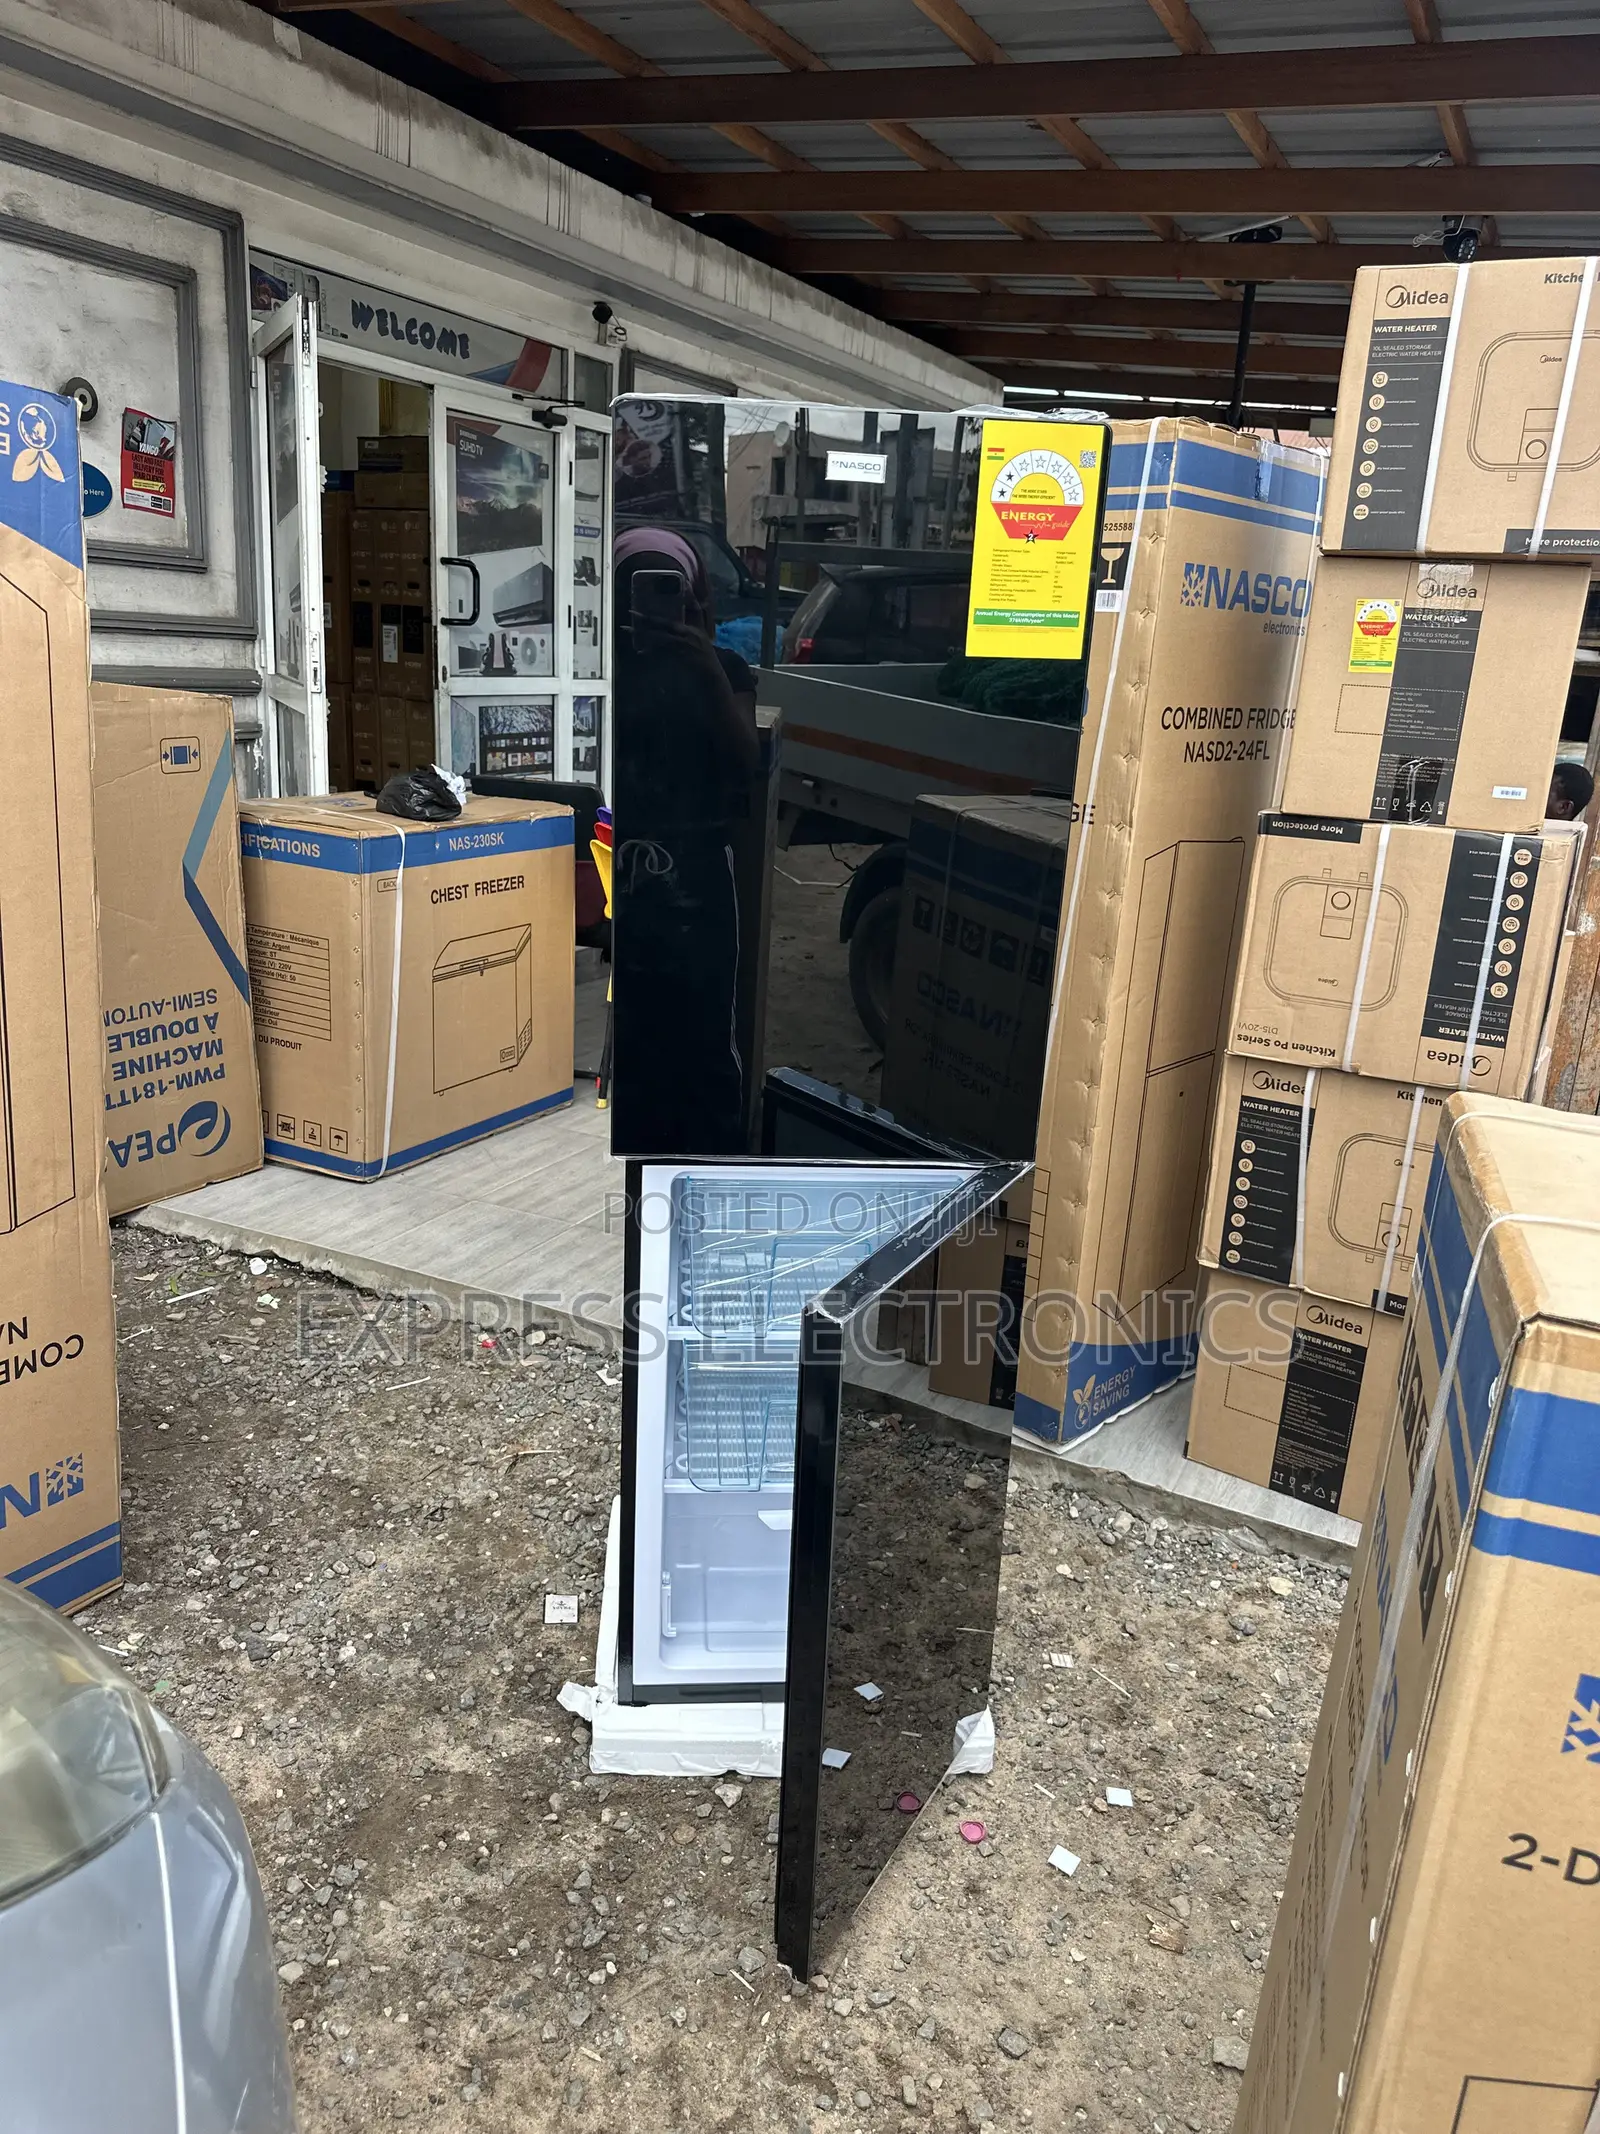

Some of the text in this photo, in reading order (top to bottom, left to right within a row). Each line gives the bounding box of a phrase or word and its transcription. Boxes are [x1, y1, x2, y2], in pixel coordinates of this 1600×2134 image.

[1544, 272, 1584, 285] Kitche
[1385, 285, 1449, 308] Midea
[351, 298, 470, 360] WELCOME
[1404, 324, 1438, 333] HEATER
[138, 442, 159, 456] YANGO
[839, 460, 882, 471] NASCO
[89, 489, 105, 497] Here
[1001, 510, 1056, 522] ENERGY
[1103, 522, 1135, 532] 525588
[1028, 533, 1034, 541] 2
[1525, 537, 1600, 547] Mre protectio
[1203, 565, 1313, 618] NASCO
[1416, 577, 1478, 598] Midea
[1404, 613, 1433, 621] WATER
[1161, 706, 1243, 731] COMBINED
[1184, 740, 1270, 763] NASD2-24FL
[1272, 820, 1344, 835] More protection
[241, 833, 321, 858] IFICATIONS
[448, 832, 505, 852] NAS-230SK
[383, 880, 397, 889] BAC
[430, 875, 525, 905] CHEST FREEZER
[271, 942, 291, 952] Argent
[1433, 1003, 1457, 1011] HEATER
[1479, 1015, 1497, 1023] SEAL
[107, 1016, 199, 1053] DOUBLE
[1438, 1026, 1470, 1037] EATER
[258, 1034, 303, 1051] DU PRODUIT
[1236, 1034, 1336, 1058] Kitchen Po Series
[111, 1038, 224, 1081] MACHINE
[105, 1062, 226, 1111] PWM-181TT
[1396, 1089, 1443, 1107] Kithen
[1242, 1100, 1300, 1117] WATER HEATER
[1241, 1122, 1265, 1131] ELECTRIC
[1249, 1118, 1270, 1127] SEALED
[105, 1122, 177, 1173] PEA
[1389, 1299, 1406, 1311] Mor
[1306, 1305, 1363, 1335] Midea
[1295, 1332, 1353, 1354] WATER HEATER
[1336, 1365, 1356, 1376] HEATER
[1094, 1366, 1136, 1399] ENERGY
[1092, 1385, 1130, 1417] SAVING
